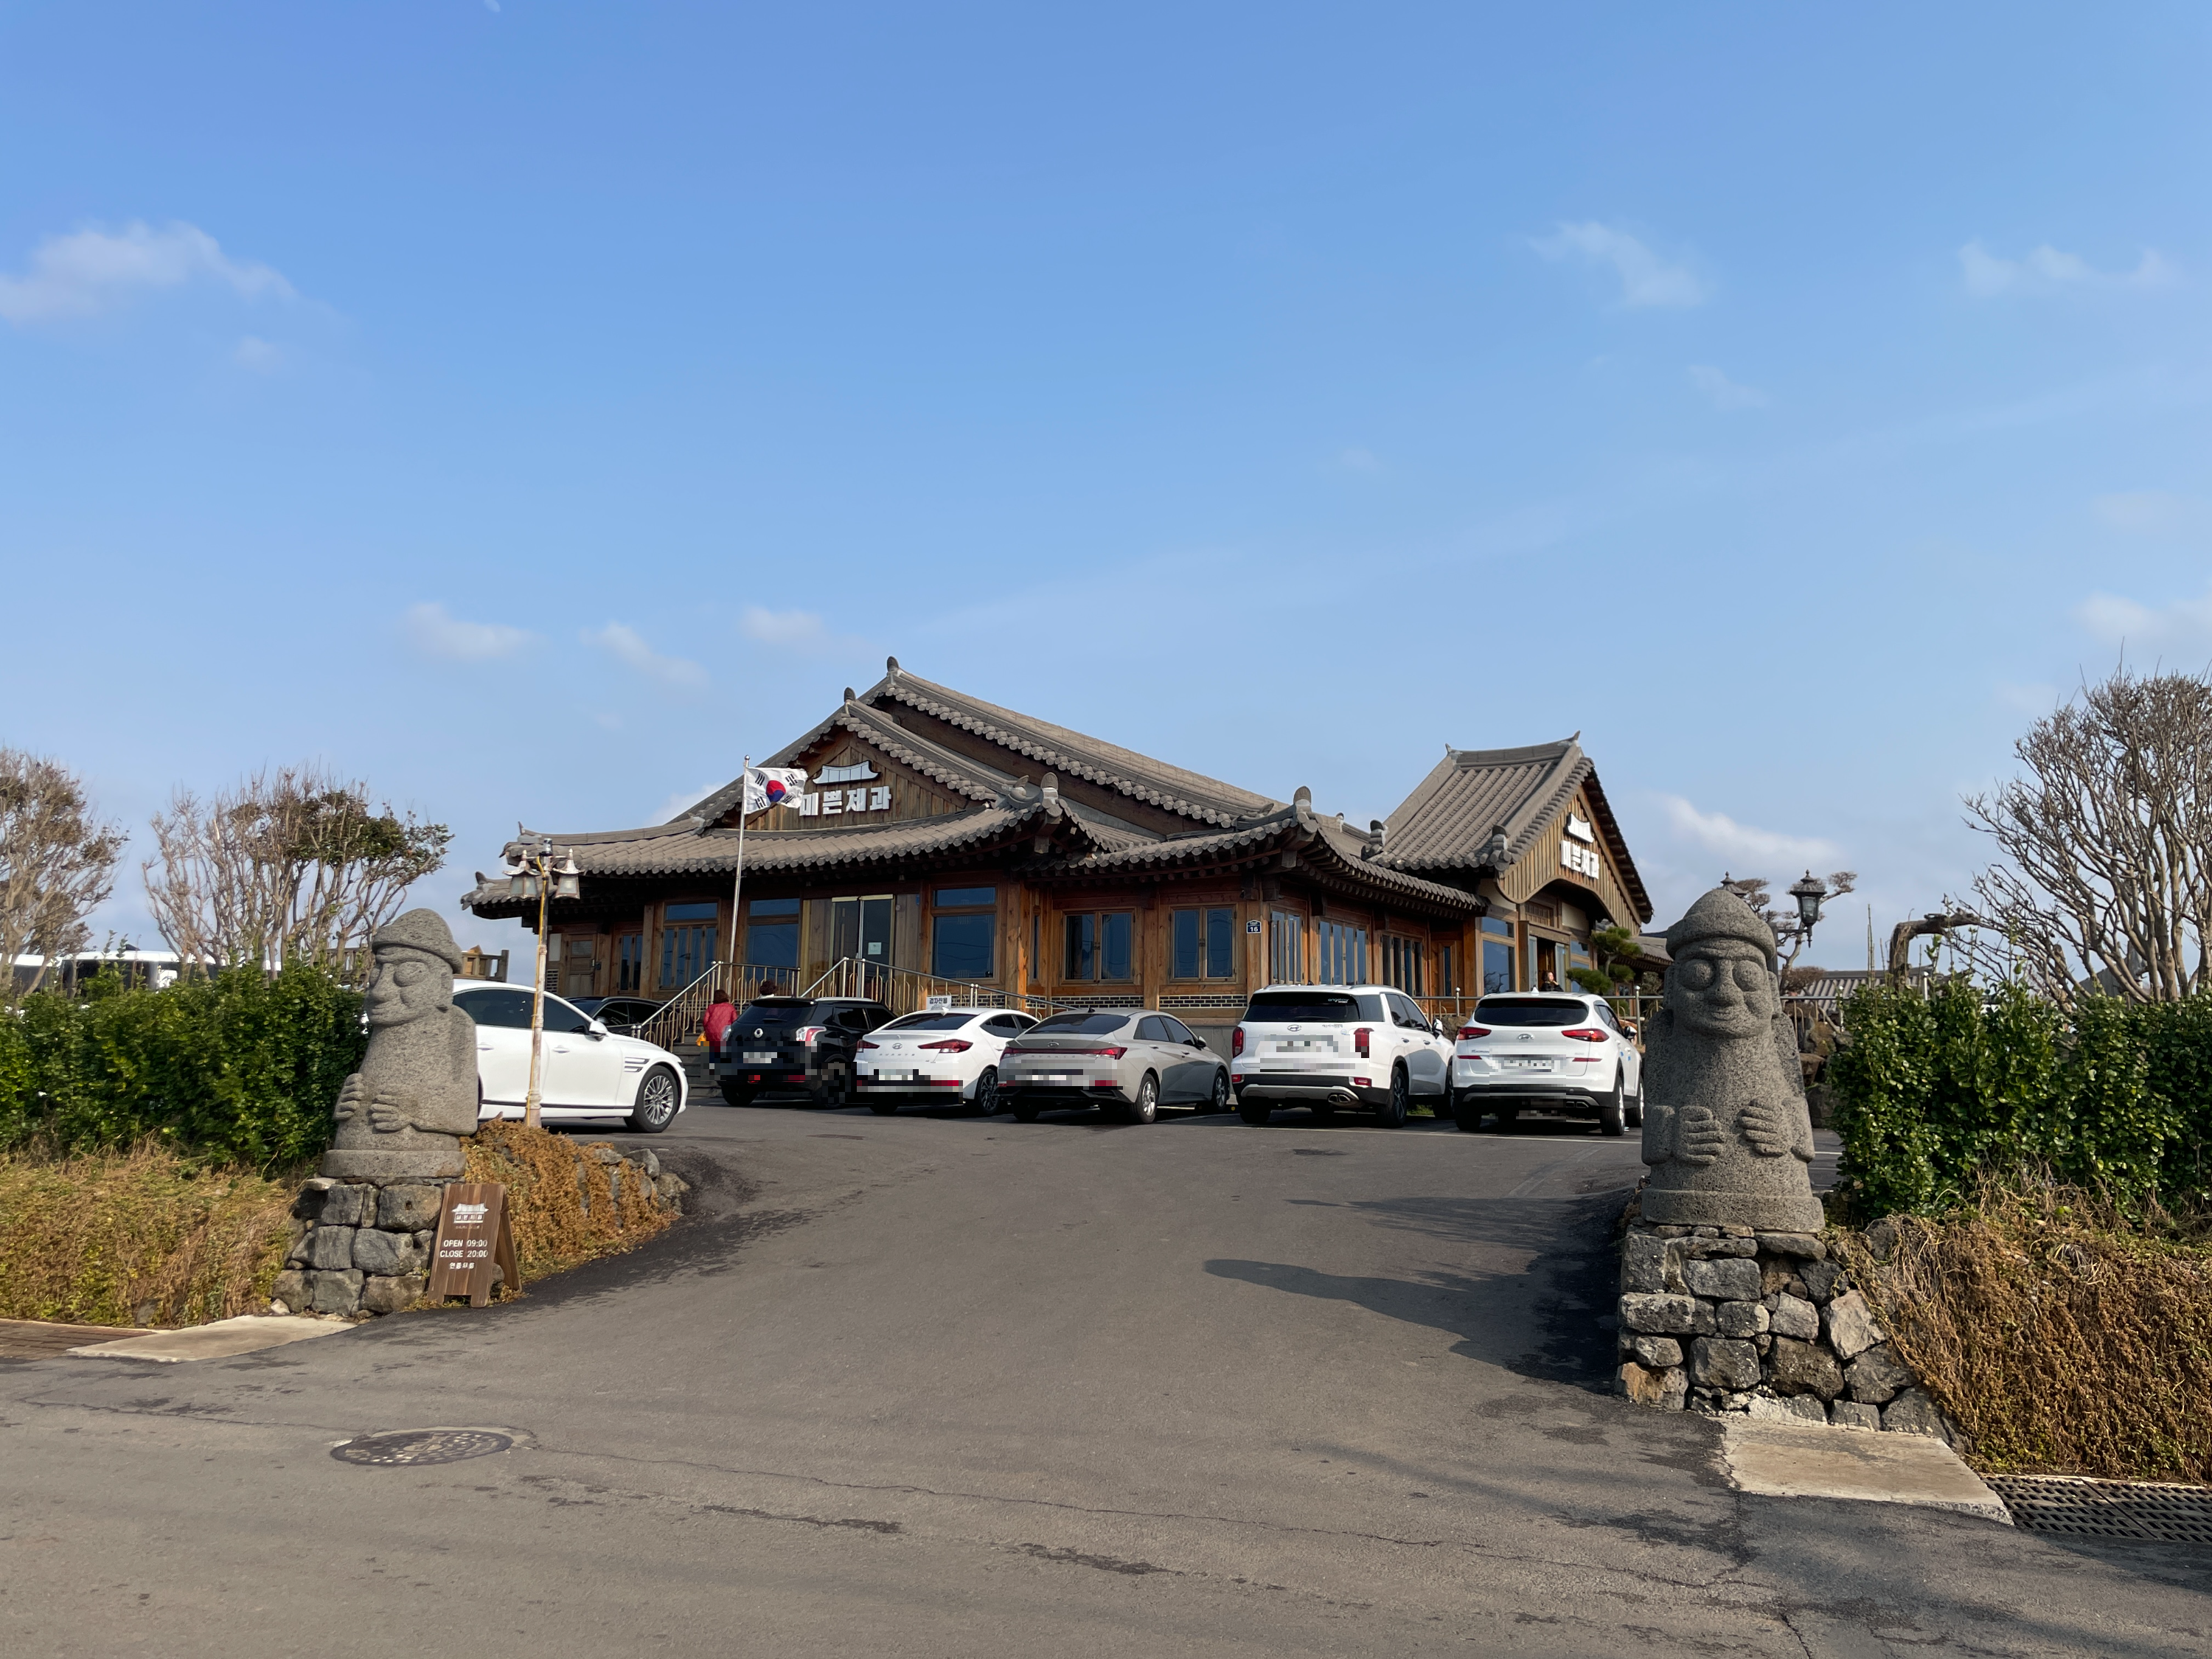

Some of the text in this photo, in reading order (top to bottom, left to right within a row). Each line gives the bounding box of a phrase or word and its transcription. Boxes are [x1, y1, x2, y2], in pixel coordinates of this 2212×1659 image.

[799, 785, 891, 816] 미쁜제과
[1560, 839, 1599, 880] 미쁜제과
[443, 1239, 488, 1248] OPEN 09:00
[439, 1250, 489, 1258] CLOSE 20:00
